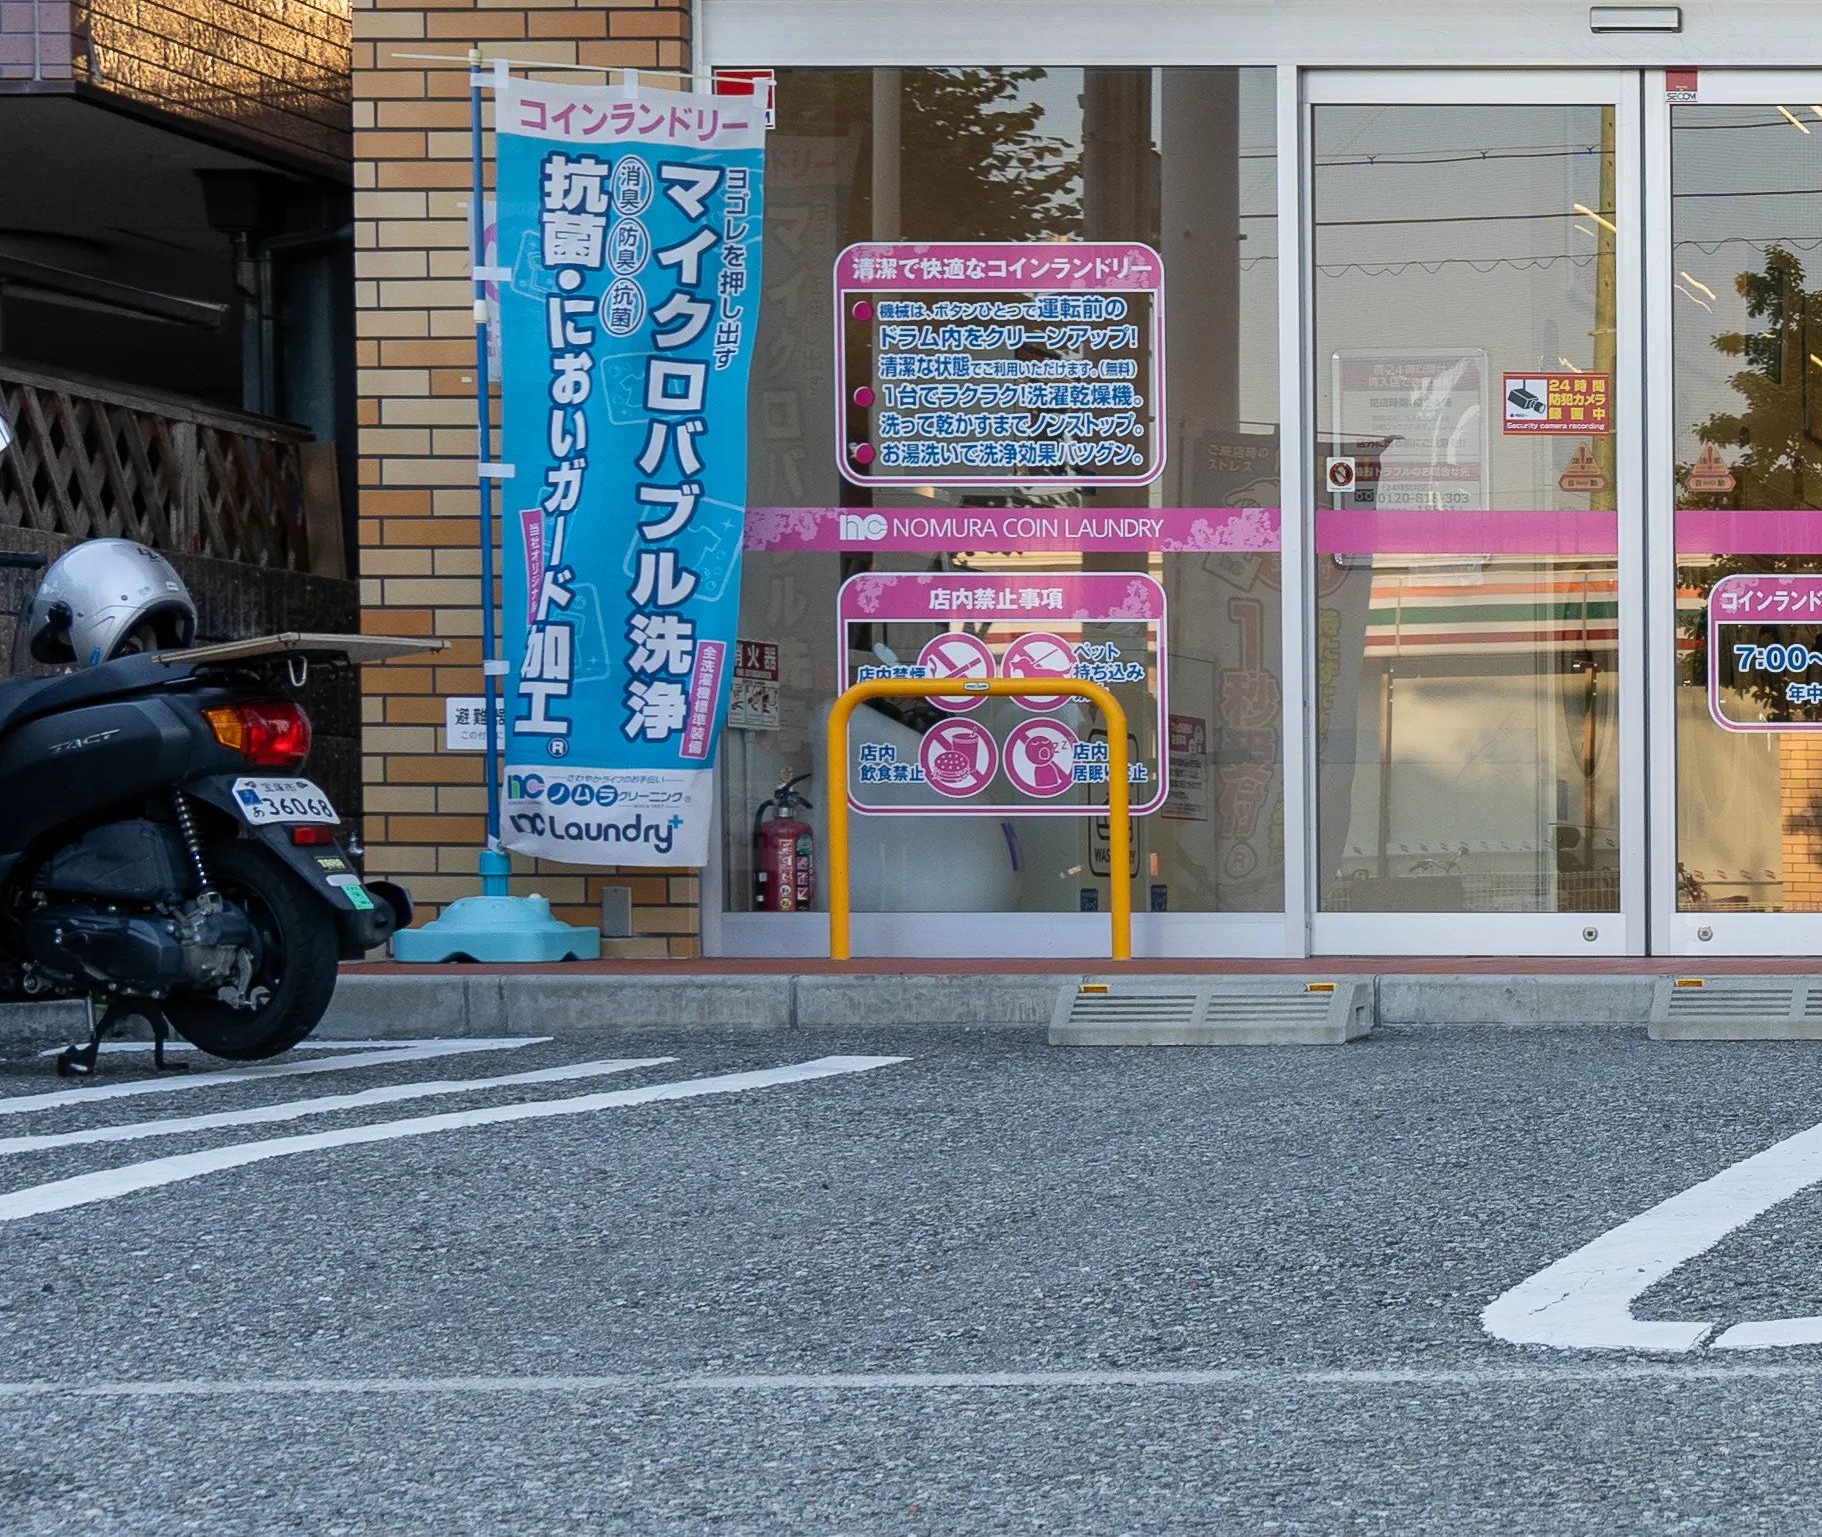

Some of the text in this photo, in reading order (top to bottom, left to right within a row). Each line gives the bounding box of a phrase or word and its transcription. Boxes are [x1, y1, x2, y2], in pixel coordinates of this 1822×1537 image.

[520, 99, 749, 141] コインランドリー
[620, 165, 641, 210] 消臭
[617, 226, 639, 269] 防臭
[715, 167, 751, 371] ヨゴレを押し出す
[852, 258, 1153, 281] 清潔で快適なコインランドリー
[611, 284, 634, 329] 抗菌
[878, 297, 1127, 320] 機械は、ボタンひとつで運転前の
[880, 325, 1139, 349] ドラム内をクリーンアップ!
[883, 385, 1143, 407] 1台でラクラク!洗濯乾燥機。
[1549, 393, 1606, 406] 防犯カメラ
[880, 413, 1143, 436] 洗って乾かすまでノンストップ。
[1507, 422, 1538, 431] Security
[1569, 422, 1605, 431] recording
[624, 165, 722, 741] マイクロバブル洗浄
[881, 443, 1143, 466] お湯洗いで洗浄効果バツグン。
[893, 518, 997, 538] NOMURA
[1002, 518, 1057, 538] COIN
[1065, 518, 1164, 538] LAUNDRY
[928, 588, 1063, 610] 店内禁止事項
[1073, 642, 1121, 660] ペット
[1073, 663, 1144, 682] 持ち込み
[860, 744, 895, 762] 店内
[1073, 743, 1108, 761] 店内
[860, 764, 924, 783] 飲食禁止
[547, 783, 683, 807] ノムラ クリーニング
[261, 798, 333, 818] 36068
